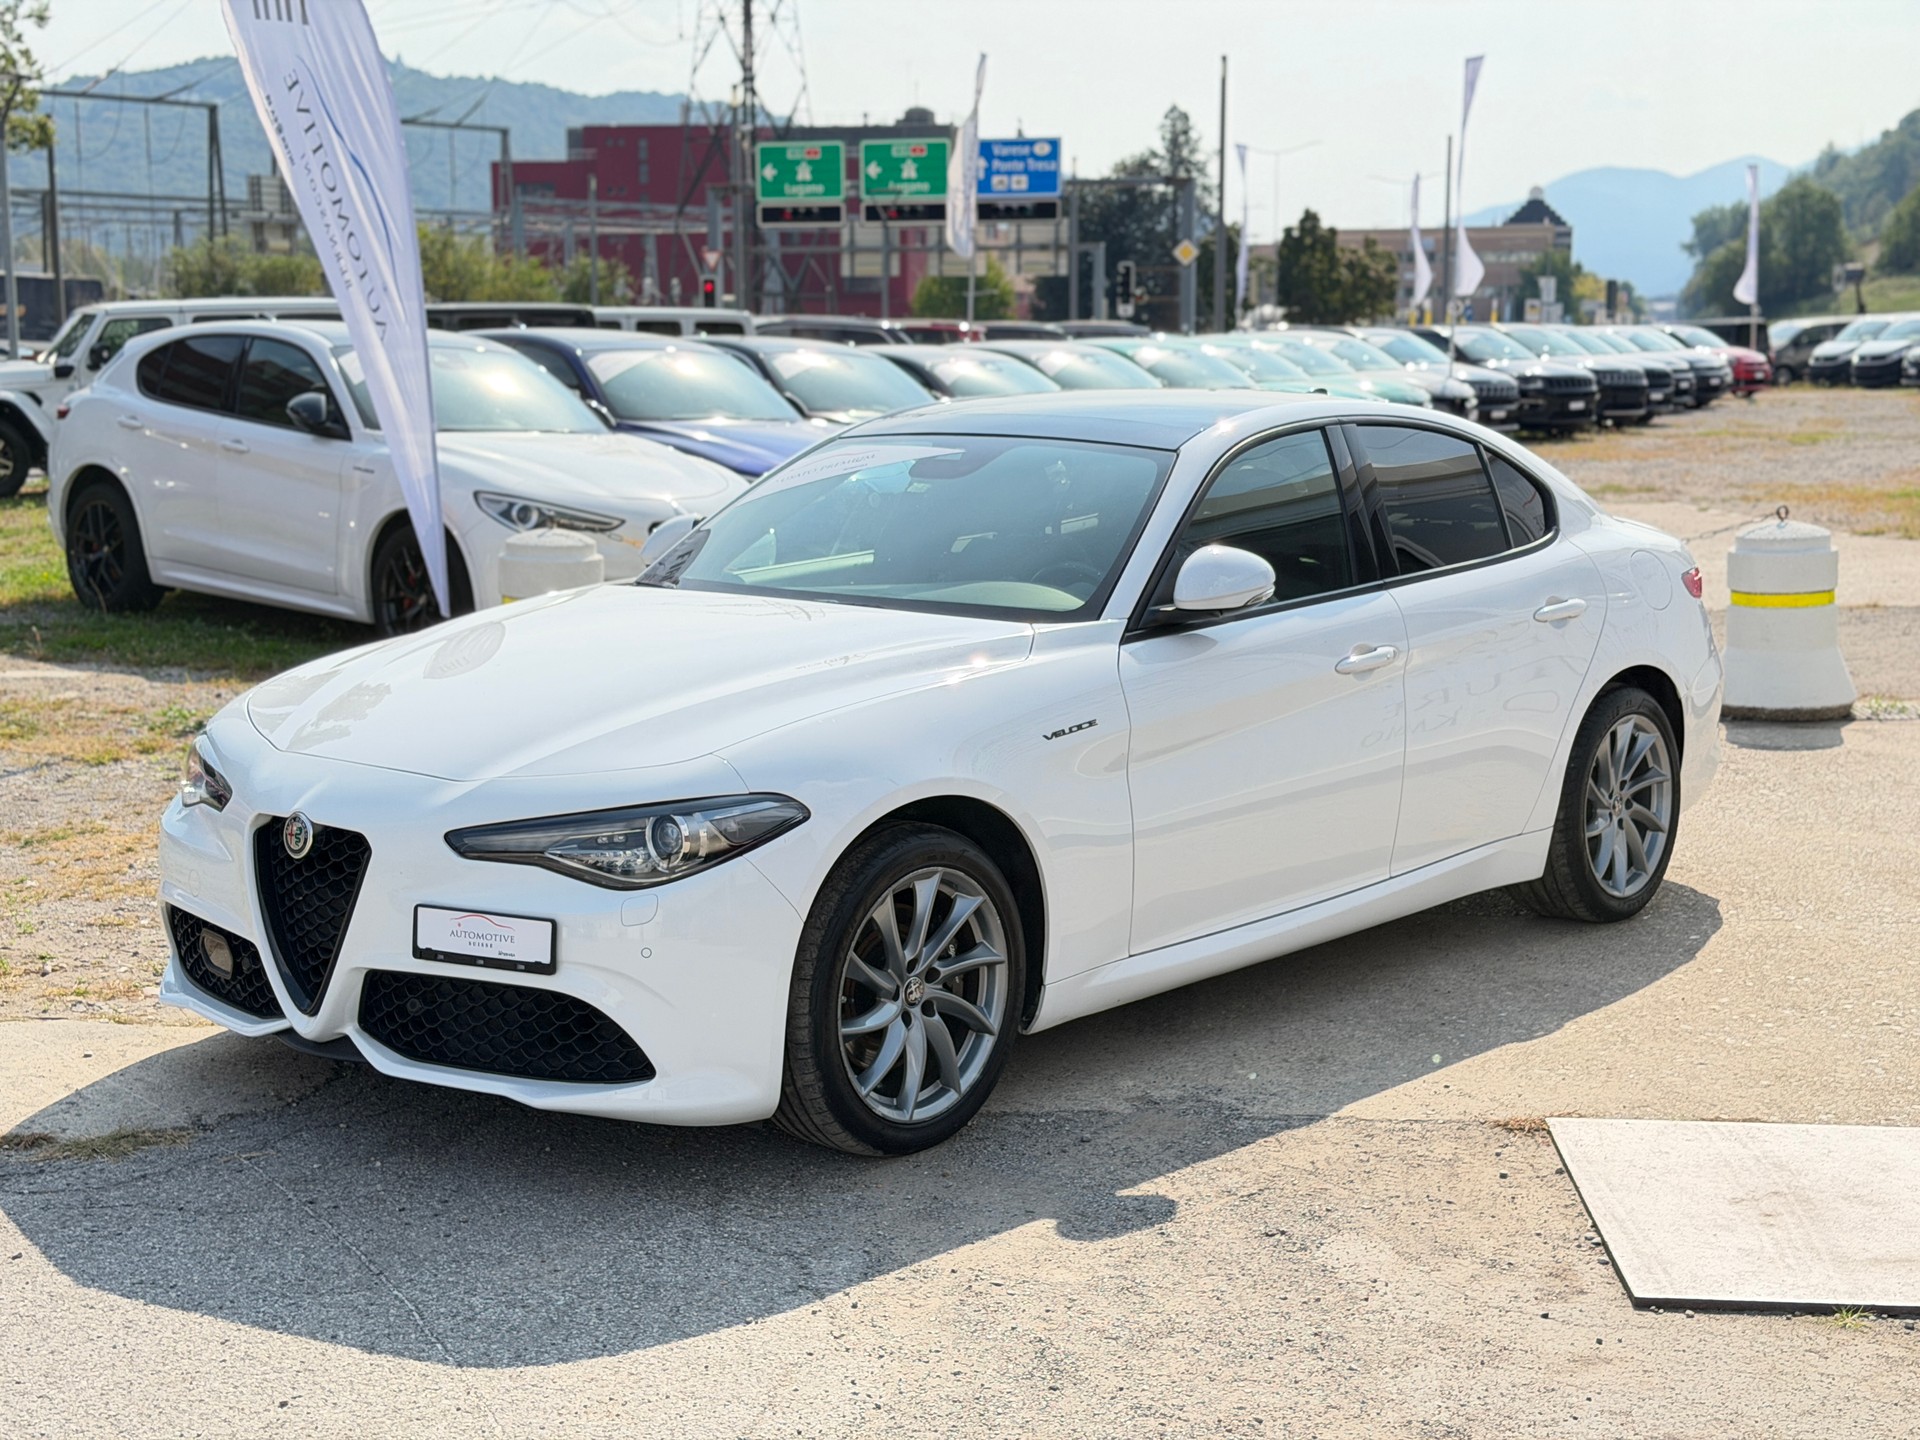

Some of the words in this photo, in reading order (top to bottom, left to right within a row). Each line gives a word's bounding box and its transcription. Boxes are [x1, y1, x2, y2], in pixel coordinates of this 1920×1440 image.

[991, 142, 1031, 157] Varese
[991, 157, 1025, 172] Ponte
[1026, 157, 1057, 172] Tresa
[783, 182, 826, 198] Lugano
[1042, 719, 1098, 740] VELOCE
[449, 930, 515, 943] AUTOMOTIVE
